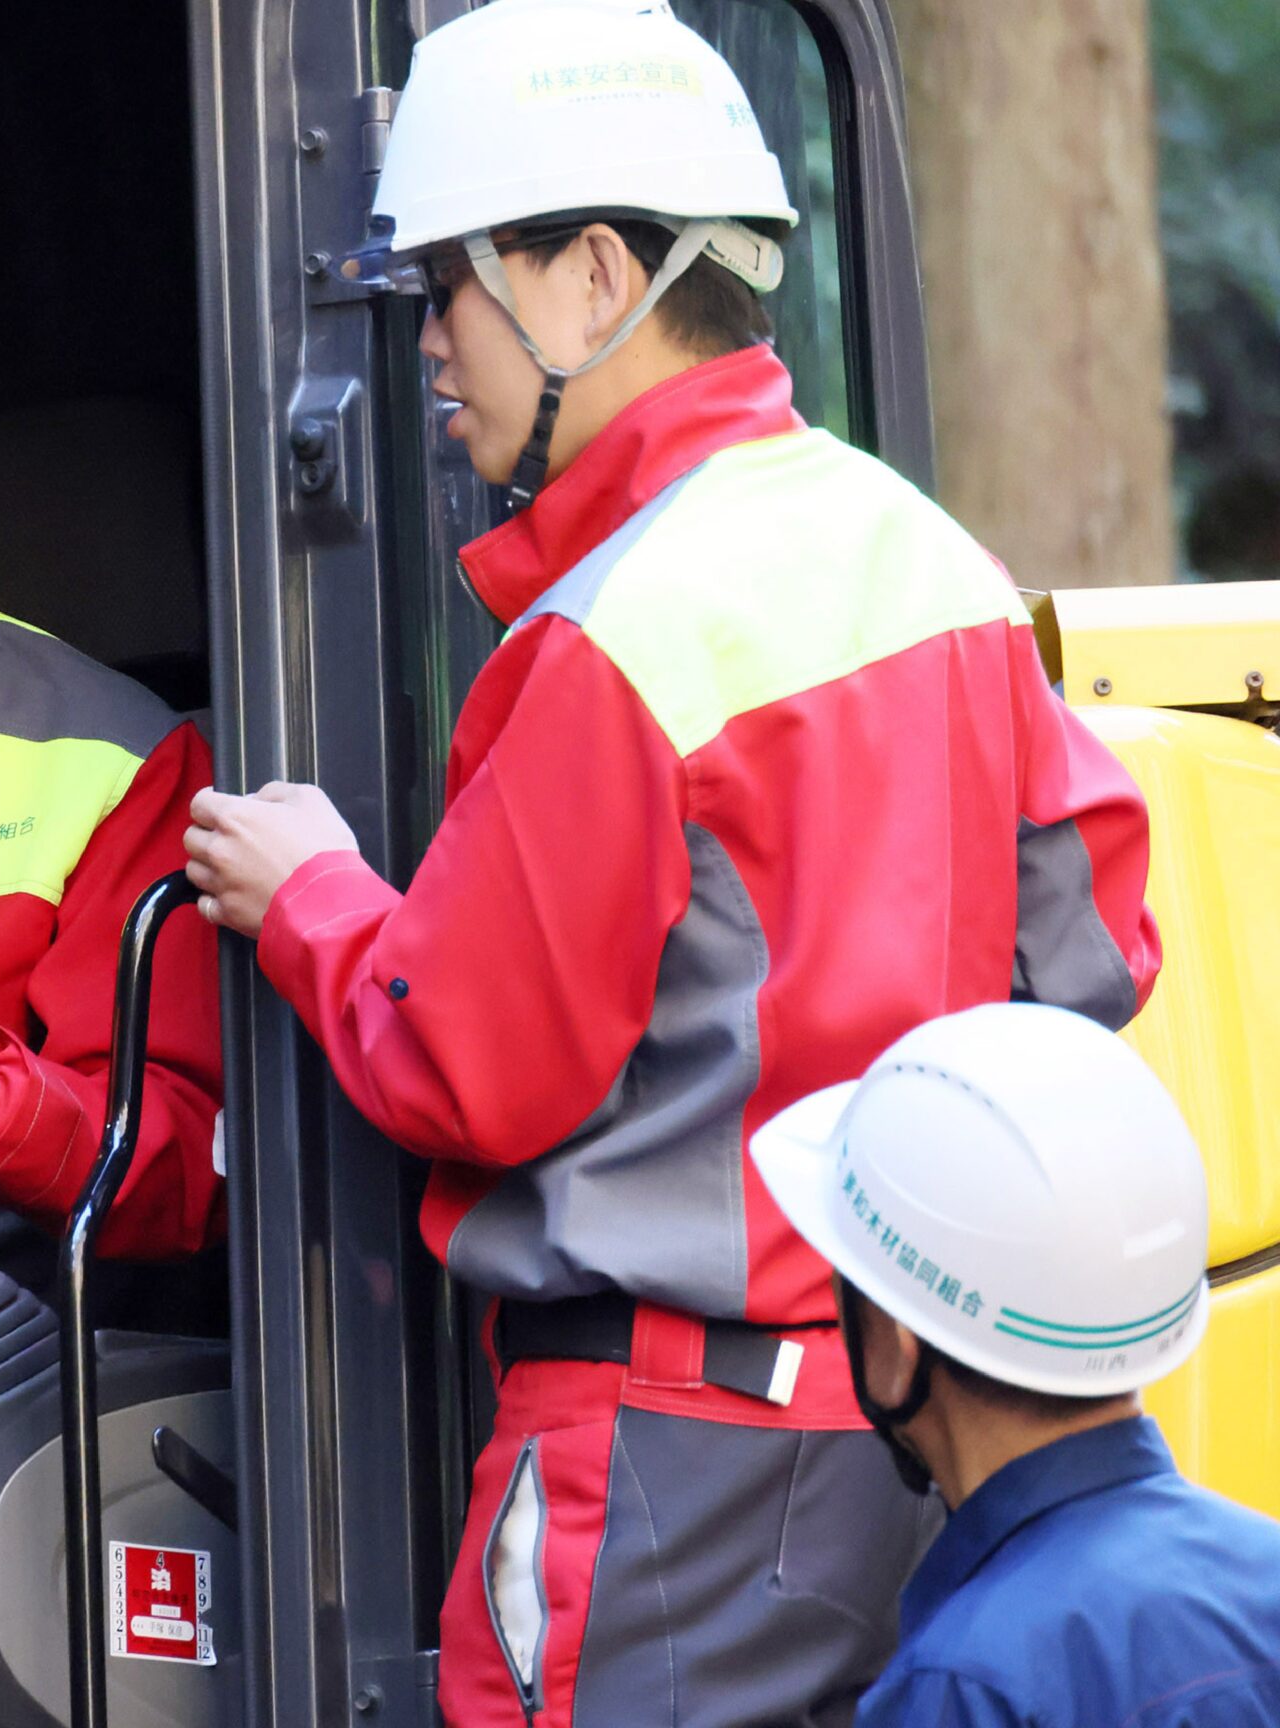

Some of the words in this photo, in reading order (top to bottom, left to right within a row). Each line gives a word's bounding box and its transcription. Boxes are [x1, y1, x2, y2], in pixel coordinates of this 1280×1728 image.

[528, 61, 690, 93] 林業安全宣言
[842, 1169, 984, 1318] 美和木材協同組合
[115, 1548, 123, 1561] 6
[198, 1557, 205, 1570] 7
[115, 1566, 123, 1580] 5
[198, 1575, 206, 1589] 8
[115, 1583, 122, 1598] 4
[198, 1593, 206, 1608] 9
[115, 1601, 123, 1615] 3
[116, 1620, 123, 1632] 2
[198, 1628, 208, 1643] 11
[117, 1636, 122, 1651] 1
[198, 1645, 210, 1659] 12
